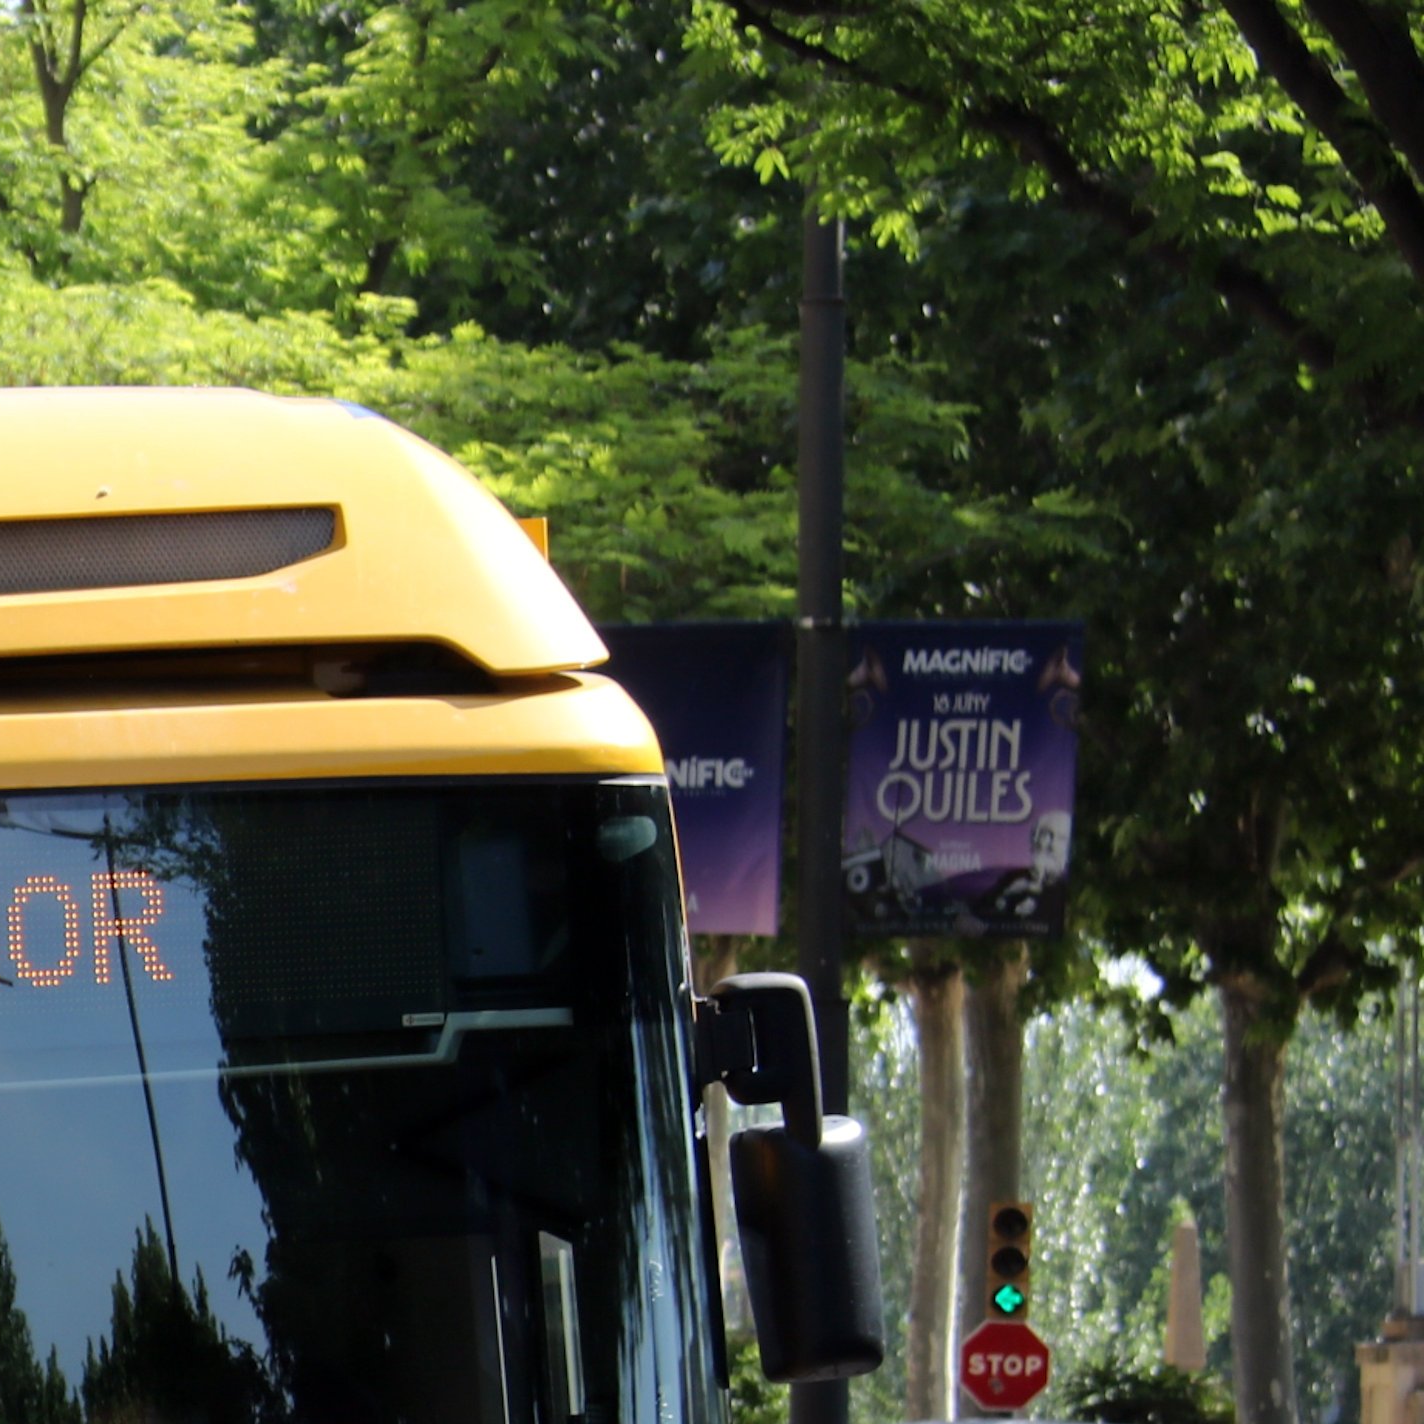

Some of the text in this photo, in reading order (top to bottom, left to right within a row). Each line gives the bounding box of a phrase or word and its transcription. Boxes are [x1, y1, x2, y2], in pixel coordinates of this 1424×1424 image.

[888, 719, 1022, 771] JUSTIN
[876, 770, 1033, 826] QUILES
[967, 1353, 1044, 1377] STOP
